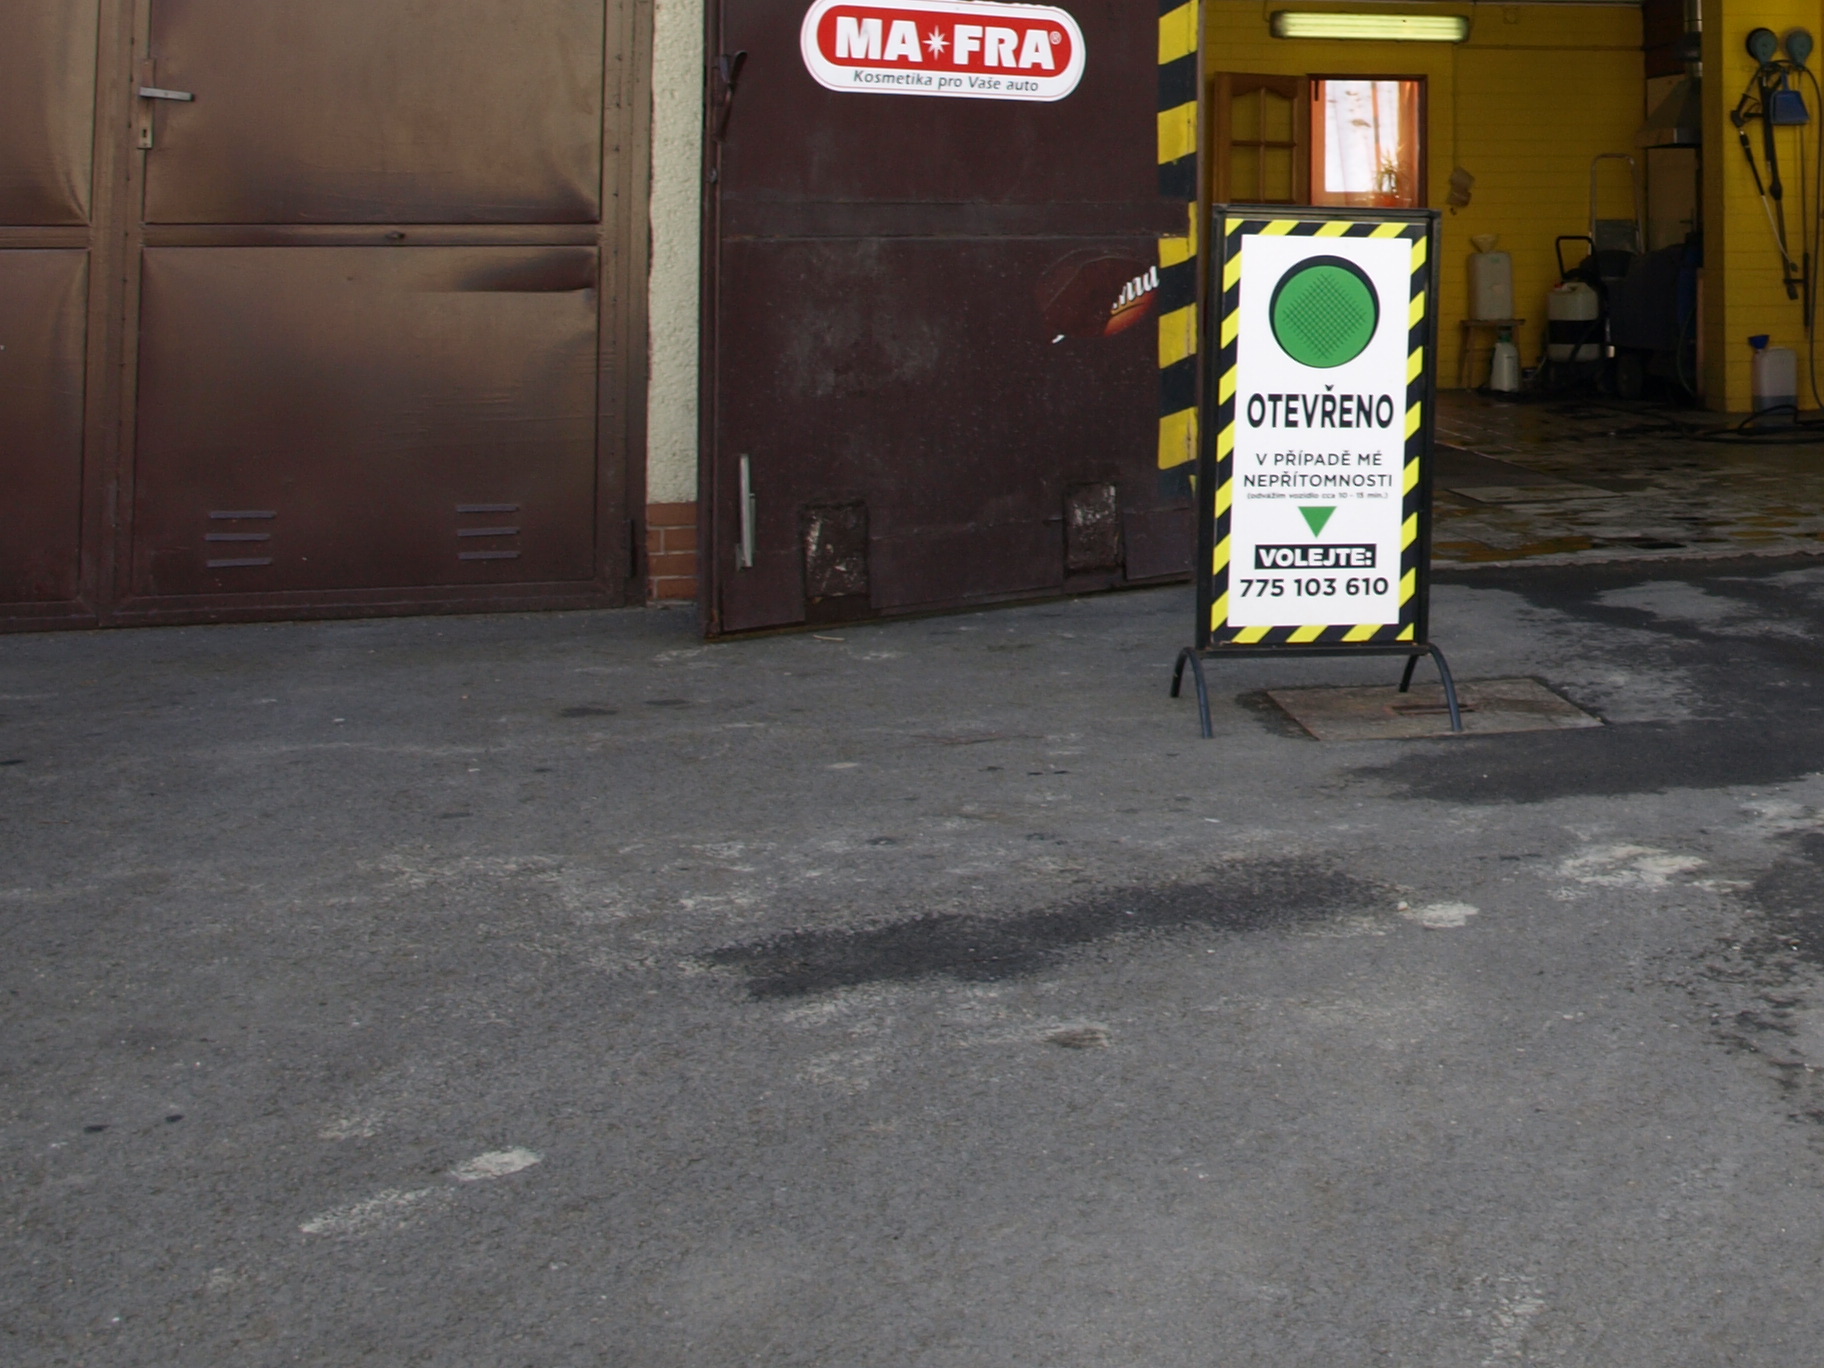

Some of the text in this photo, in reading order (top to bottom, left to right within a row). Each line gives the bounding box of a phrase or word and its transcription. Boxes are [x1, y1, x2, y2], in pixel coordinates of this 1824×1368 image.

[853, 70, 1038, 92] Kosmetika pro Vaše auto
[1246, 384, 1395, 429] OTEVŘENO
[1256, 450, 1383, 467] V PŘÍPADĚ MÉ
[1243, 471, 1393, 488] NEPŘÍTOMNOSTI
[1257, 546, 1373, 568] VOLEJTE:
[1239, 577, 1389, 597] 775 103 610
